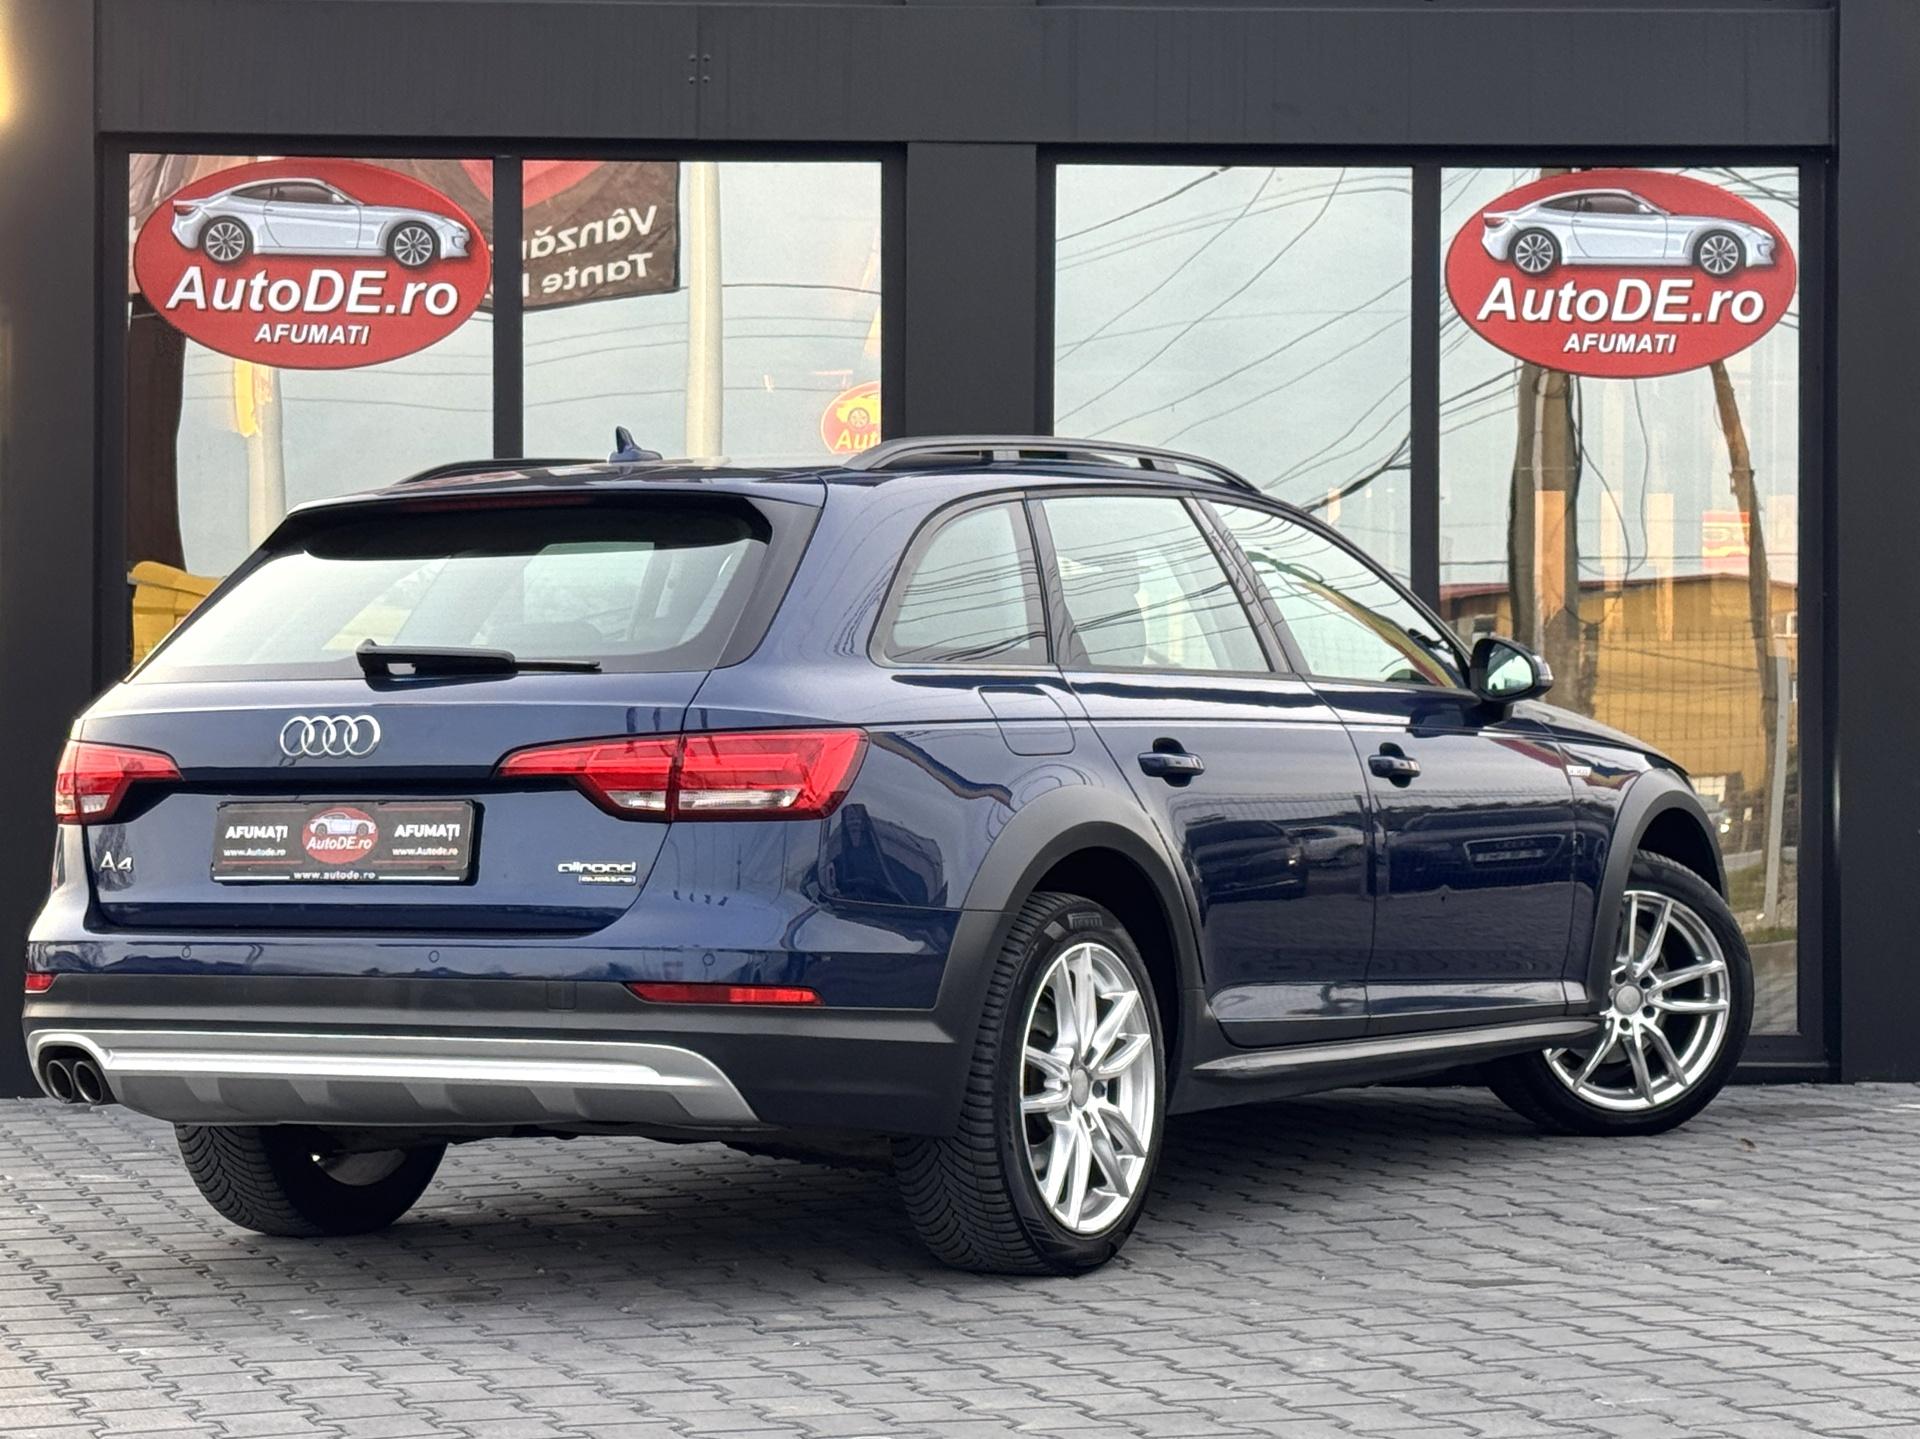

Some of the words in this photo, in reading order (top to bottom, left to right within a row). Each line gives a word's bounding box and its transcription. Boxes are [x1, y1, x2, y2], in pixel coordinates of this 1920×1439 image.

[165, 265, 459, 316] AutoDE.ro
[1476, 277, 1765, 323] AutoDE.ro
[254, 323, 370, 345] AFUMATI
[1562, 332, 1677, 354] AFUMATI
[306, 836, 372, 851] AutoDE.ro
[100, 850, 133, 873] A4
[557, 861, 636, 873] allroad
[293, 870, 377, 880] www.autode.ro
